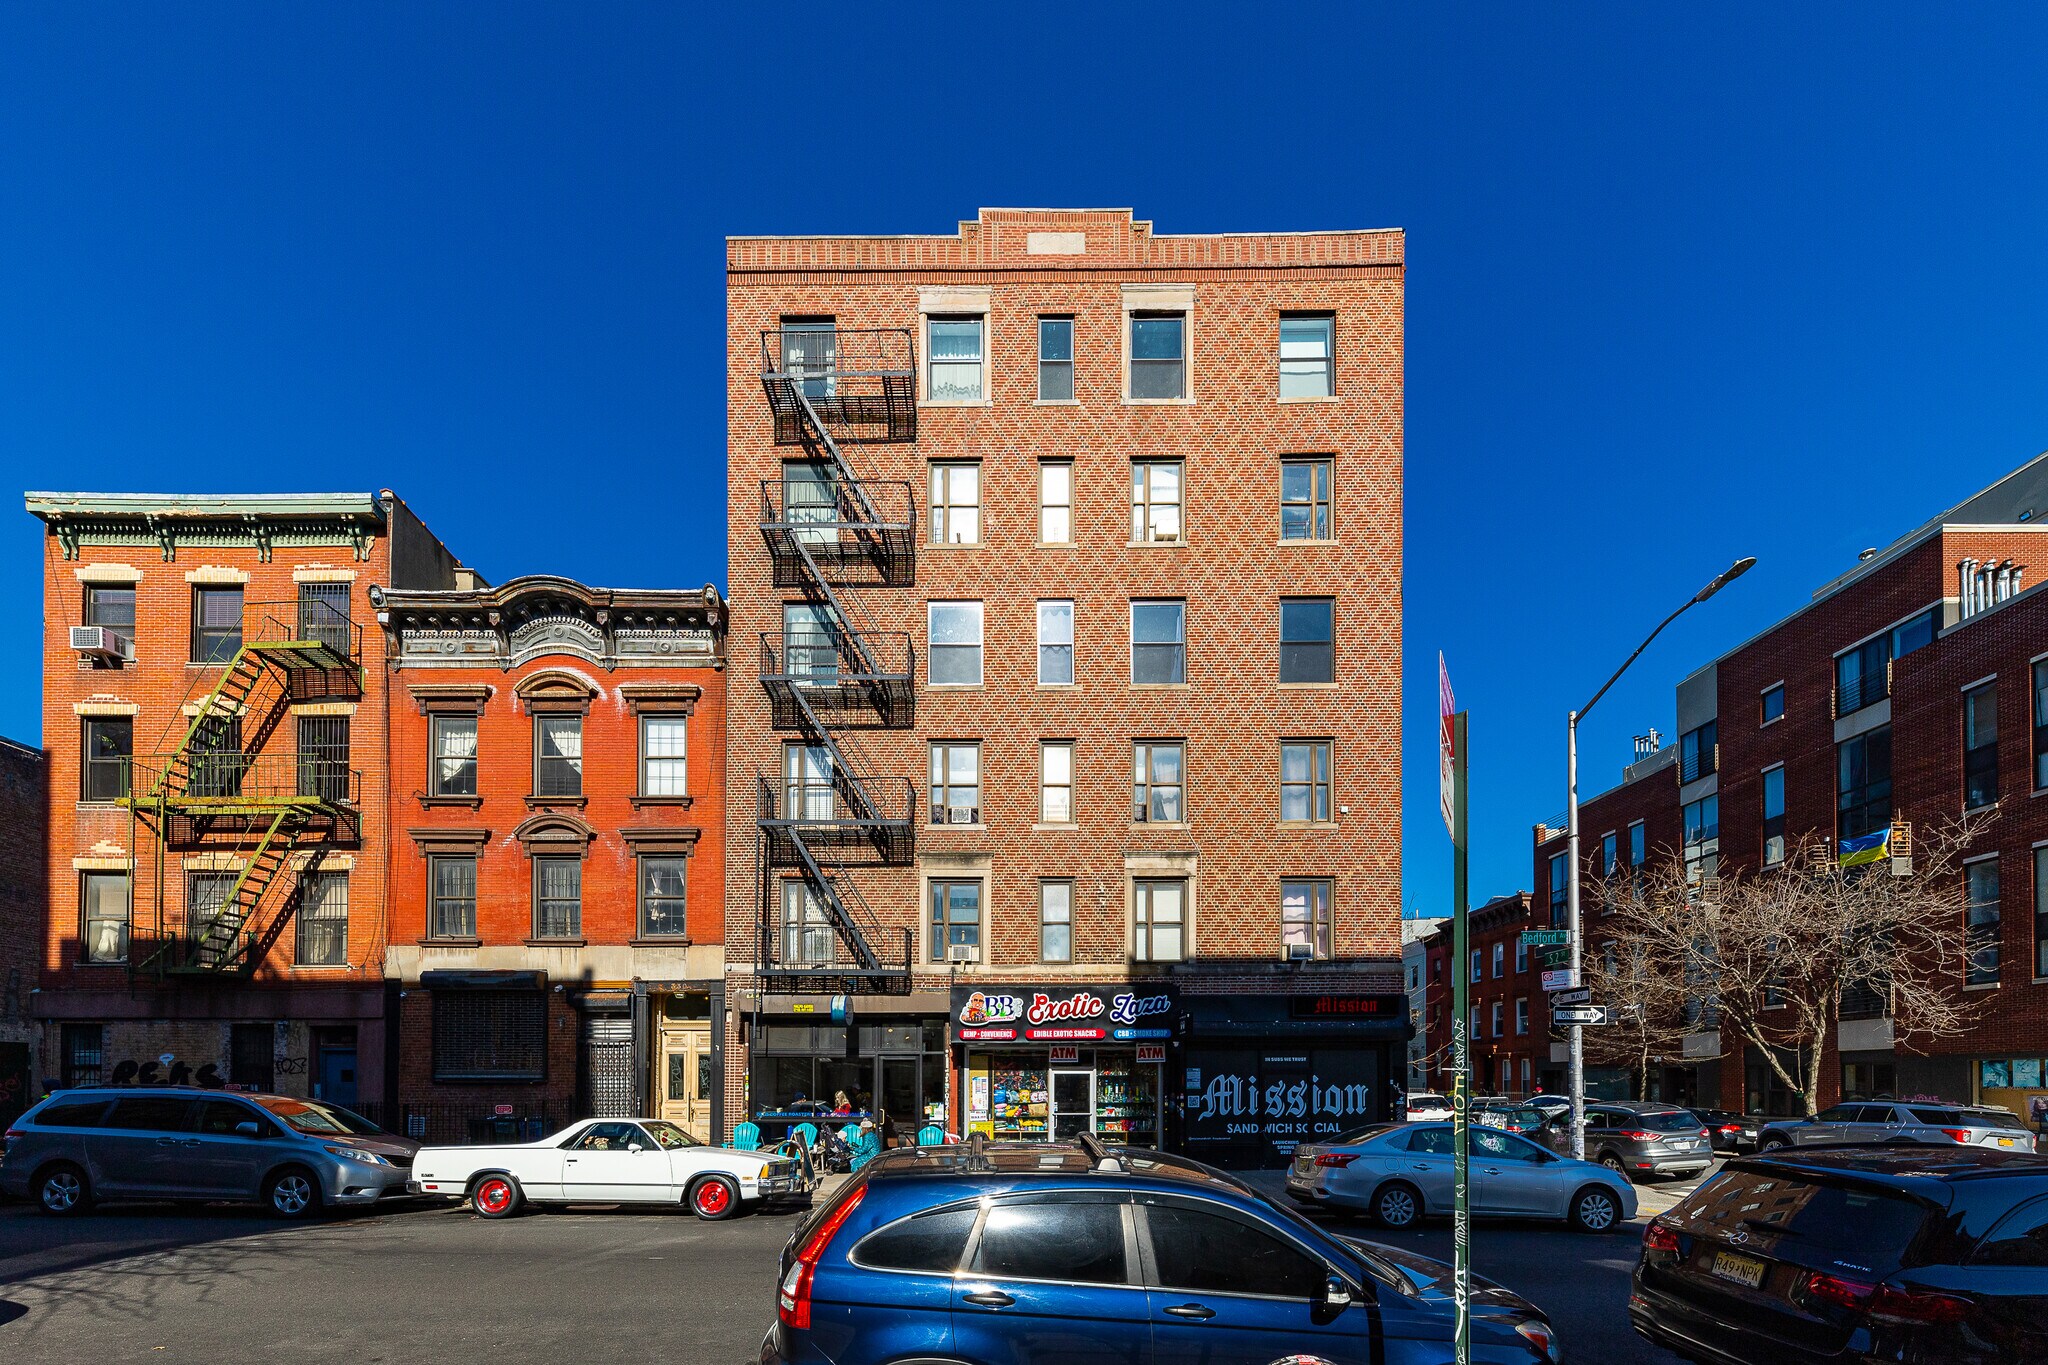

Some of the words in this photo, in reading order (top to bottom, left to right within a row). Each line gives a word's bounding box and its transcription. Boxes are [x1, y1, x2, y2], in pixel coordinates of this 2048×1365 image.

[1522, 932, 1557, 943] Bedford
[1571, 992, 1584, 1000] WAY
[1027, 993, 1105, 1025] Exotic
[1110, 993, 1172, 1024] Zaza
[1314, 996, 1378, 1014] Mission
[1561, 1011, 1576, 1019] ONE
[1583, 1011, 1598, 1019] WAY
[963, 1030, 977, 1038] HEMP
[981, 1030, 1013, 1038] CONVENIENCE
[1034, 1030, 1053, 1038] EDIBLE
[1053, 1030, 1073, 1038] EXOTIC
[1074, 1030, 1097, 1038] SNACKS
[1051, 1047, 1077, 1059] ATM
[1138, 1047, 1163, 1059] ATM
[1198, 1074, 1369, 1121] Mission
